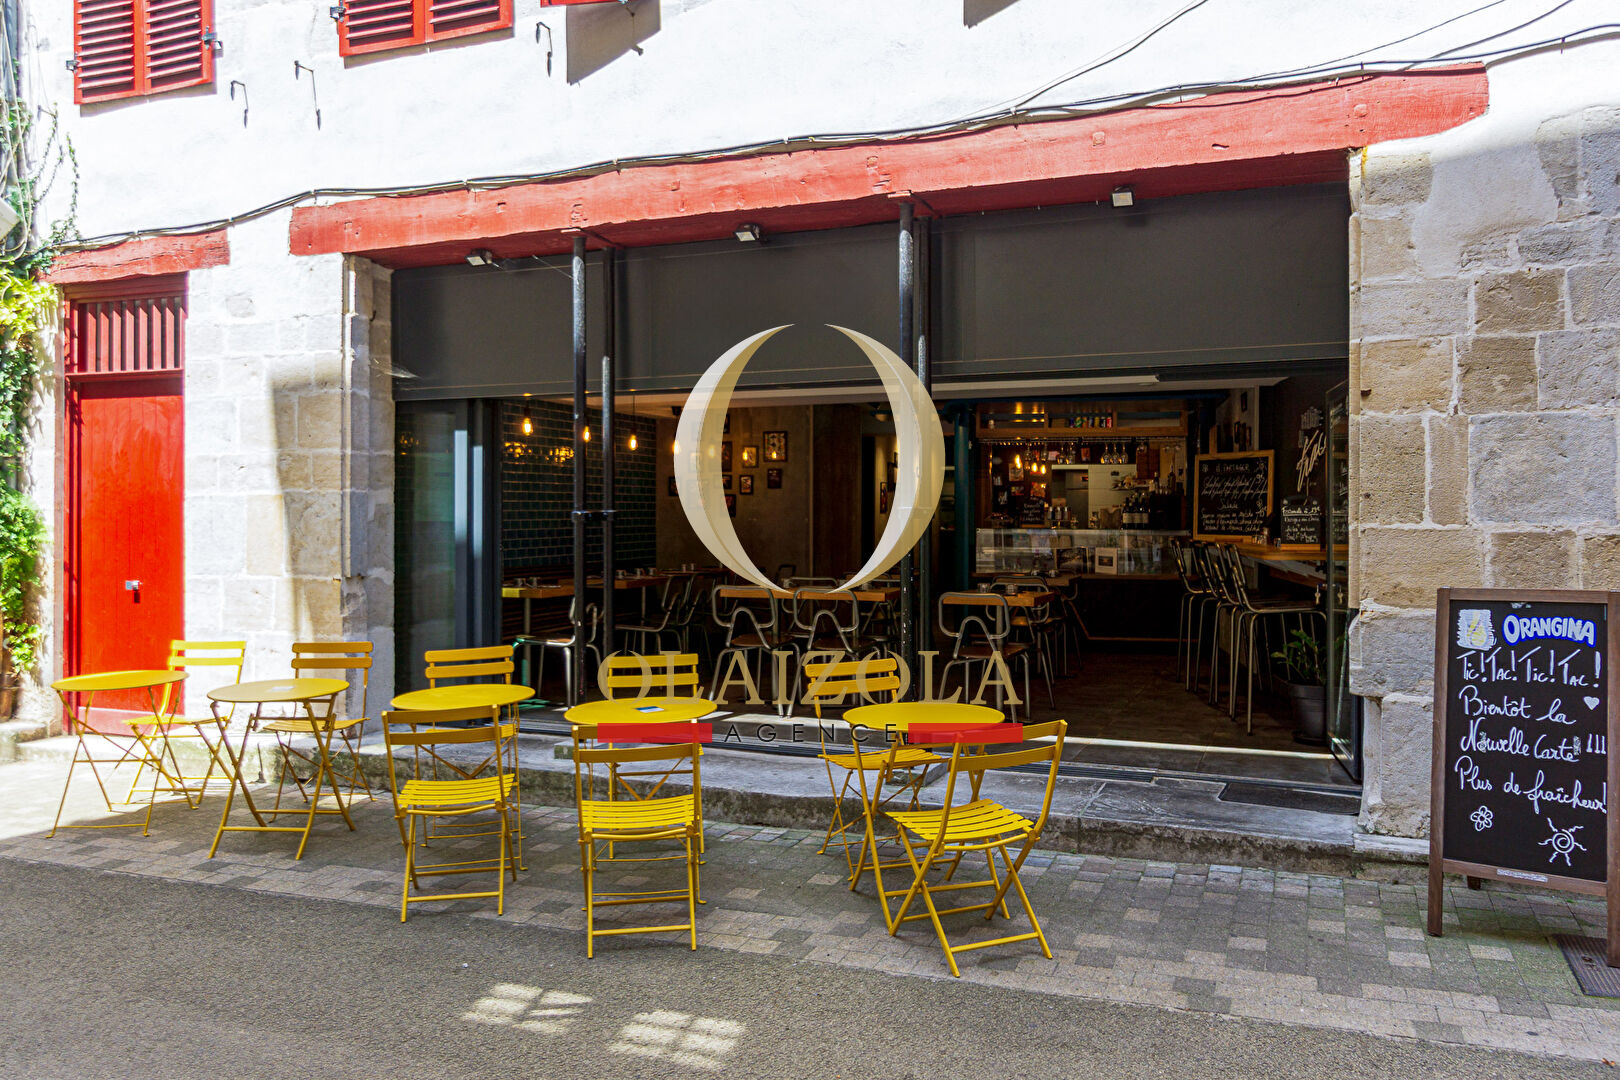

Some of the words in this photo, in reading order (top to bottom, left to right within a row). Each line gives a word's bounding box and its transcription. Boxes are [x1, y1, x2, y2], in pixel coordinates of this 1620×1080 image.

[1459, 685, 1531, 719] Bientôt
[1536, 698, 1576, 725] la
[1455, 755, 1493, 791] Plus
[1503, 771, 1522, 796] de
